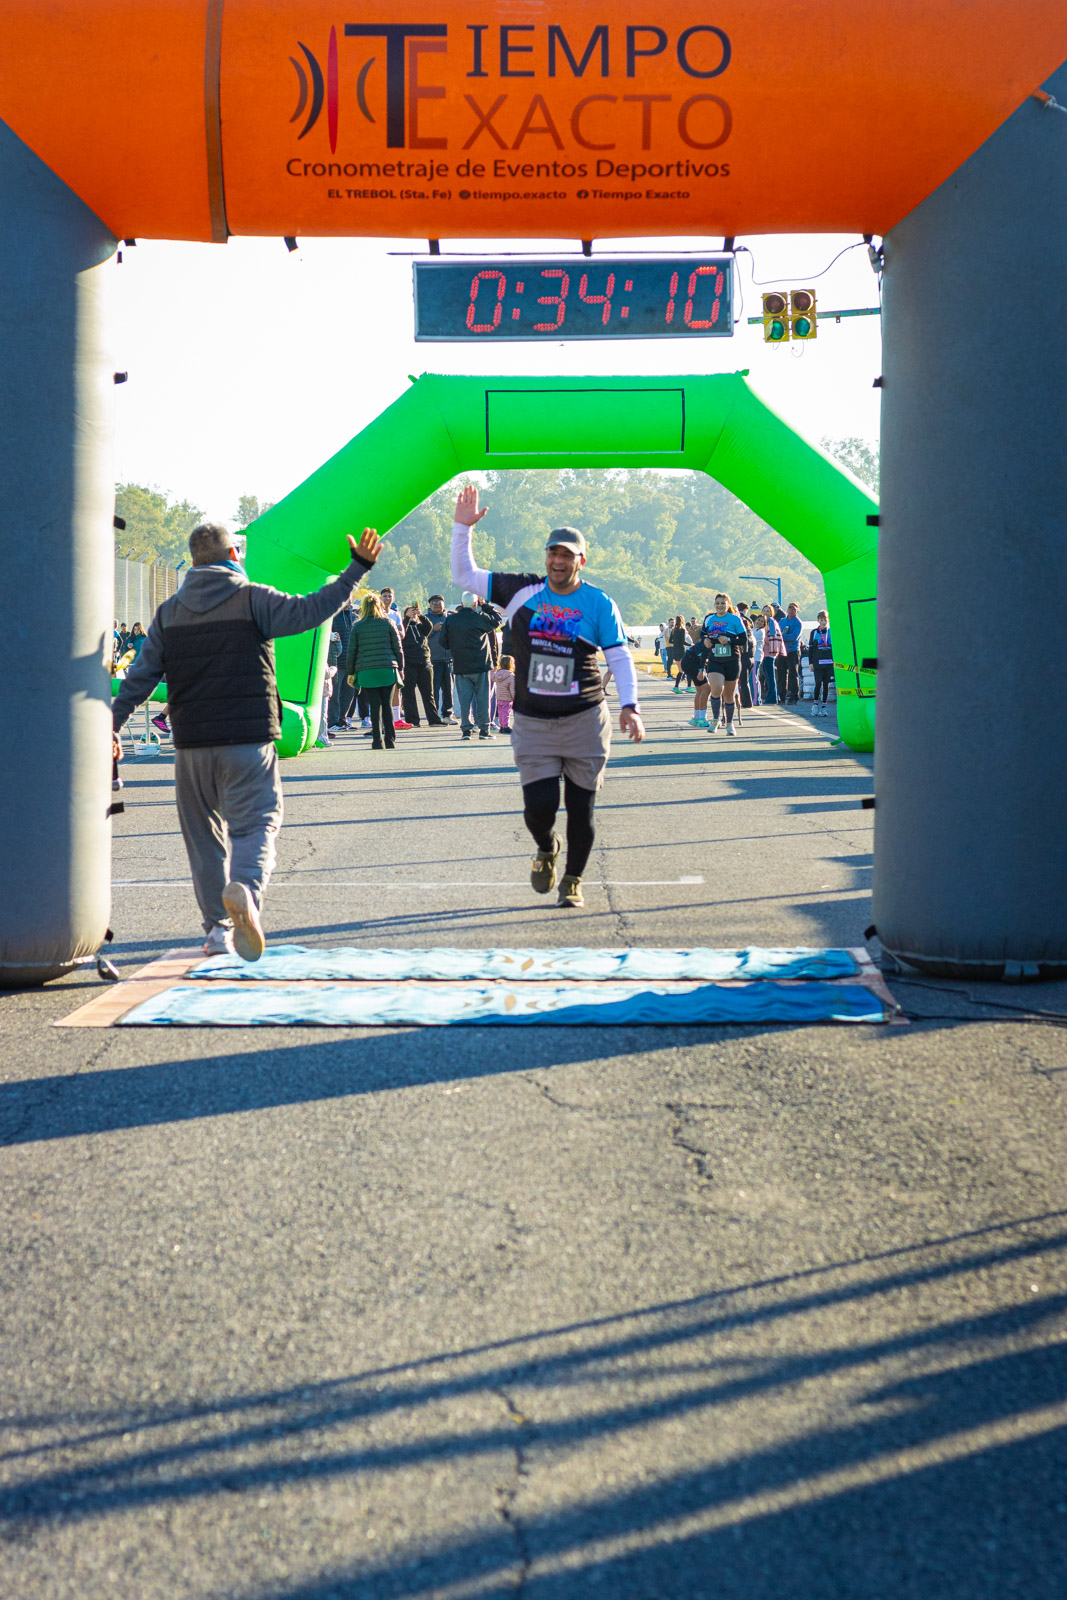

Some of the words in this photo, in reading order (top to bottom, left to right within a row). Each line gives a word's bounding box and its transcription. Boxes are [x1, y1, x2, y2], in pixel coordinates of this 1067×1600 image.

[286, 158, 449, 182] Cronometraje
[455, 158, 486, 178] de
[493, 158, 588, 178] Eventos
[595, 158, 731, 182] Deportivos
[328, 189, 343, 199] EL
[345, 189, 397, 199] TREBOL
[432, 189, 452, 200] Fe)
[591, 189, 643, 201] Tiempo
[645, 189, 690, 200] Exacto
[535, 662, 565, 684] 139
